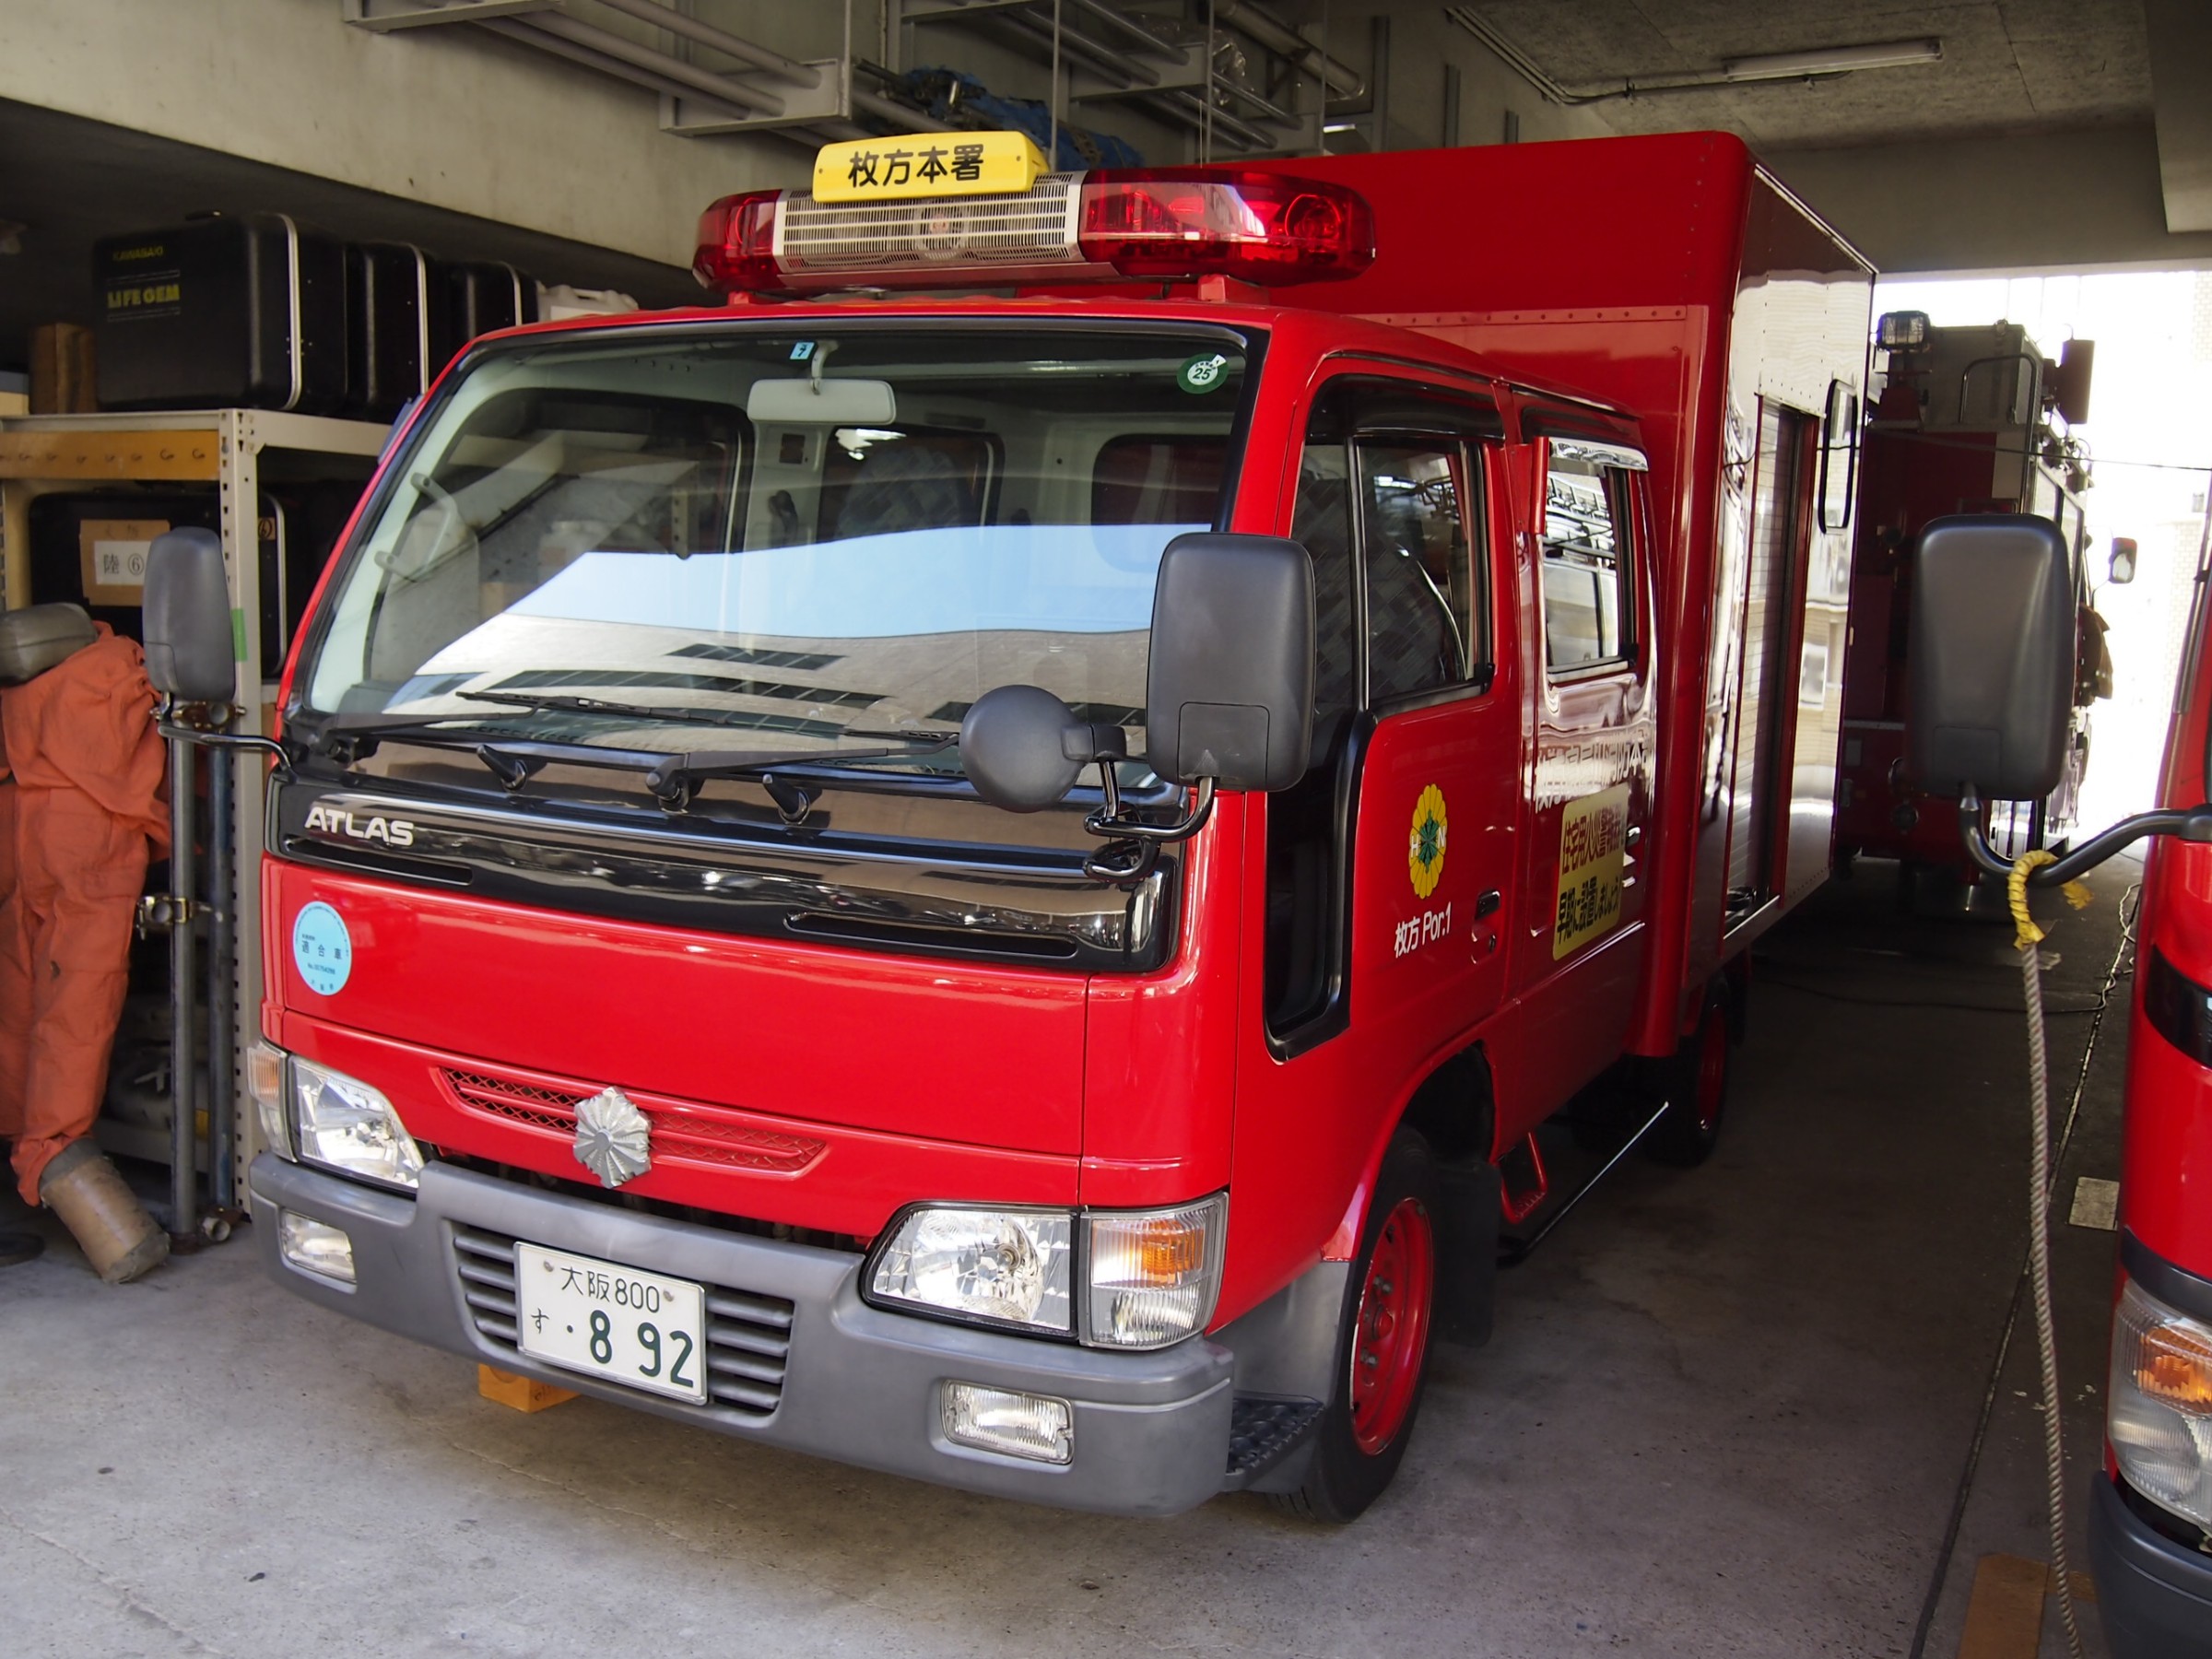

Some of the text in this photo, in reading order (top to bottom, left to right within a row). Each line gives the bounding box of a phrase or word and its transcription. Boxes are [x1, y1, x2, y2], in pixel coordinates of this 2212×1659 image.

[848, 143, 984, 188] 枚方本署
[107, 284, 181, 309] LIFE GEM
[1192, 367, 1212, 381] 25
[304, 806, 415, 846] ATLAS
[1410, 825, 1446, 858] H N
[1394, 901, 1452, 959] 枚方 Por.1
